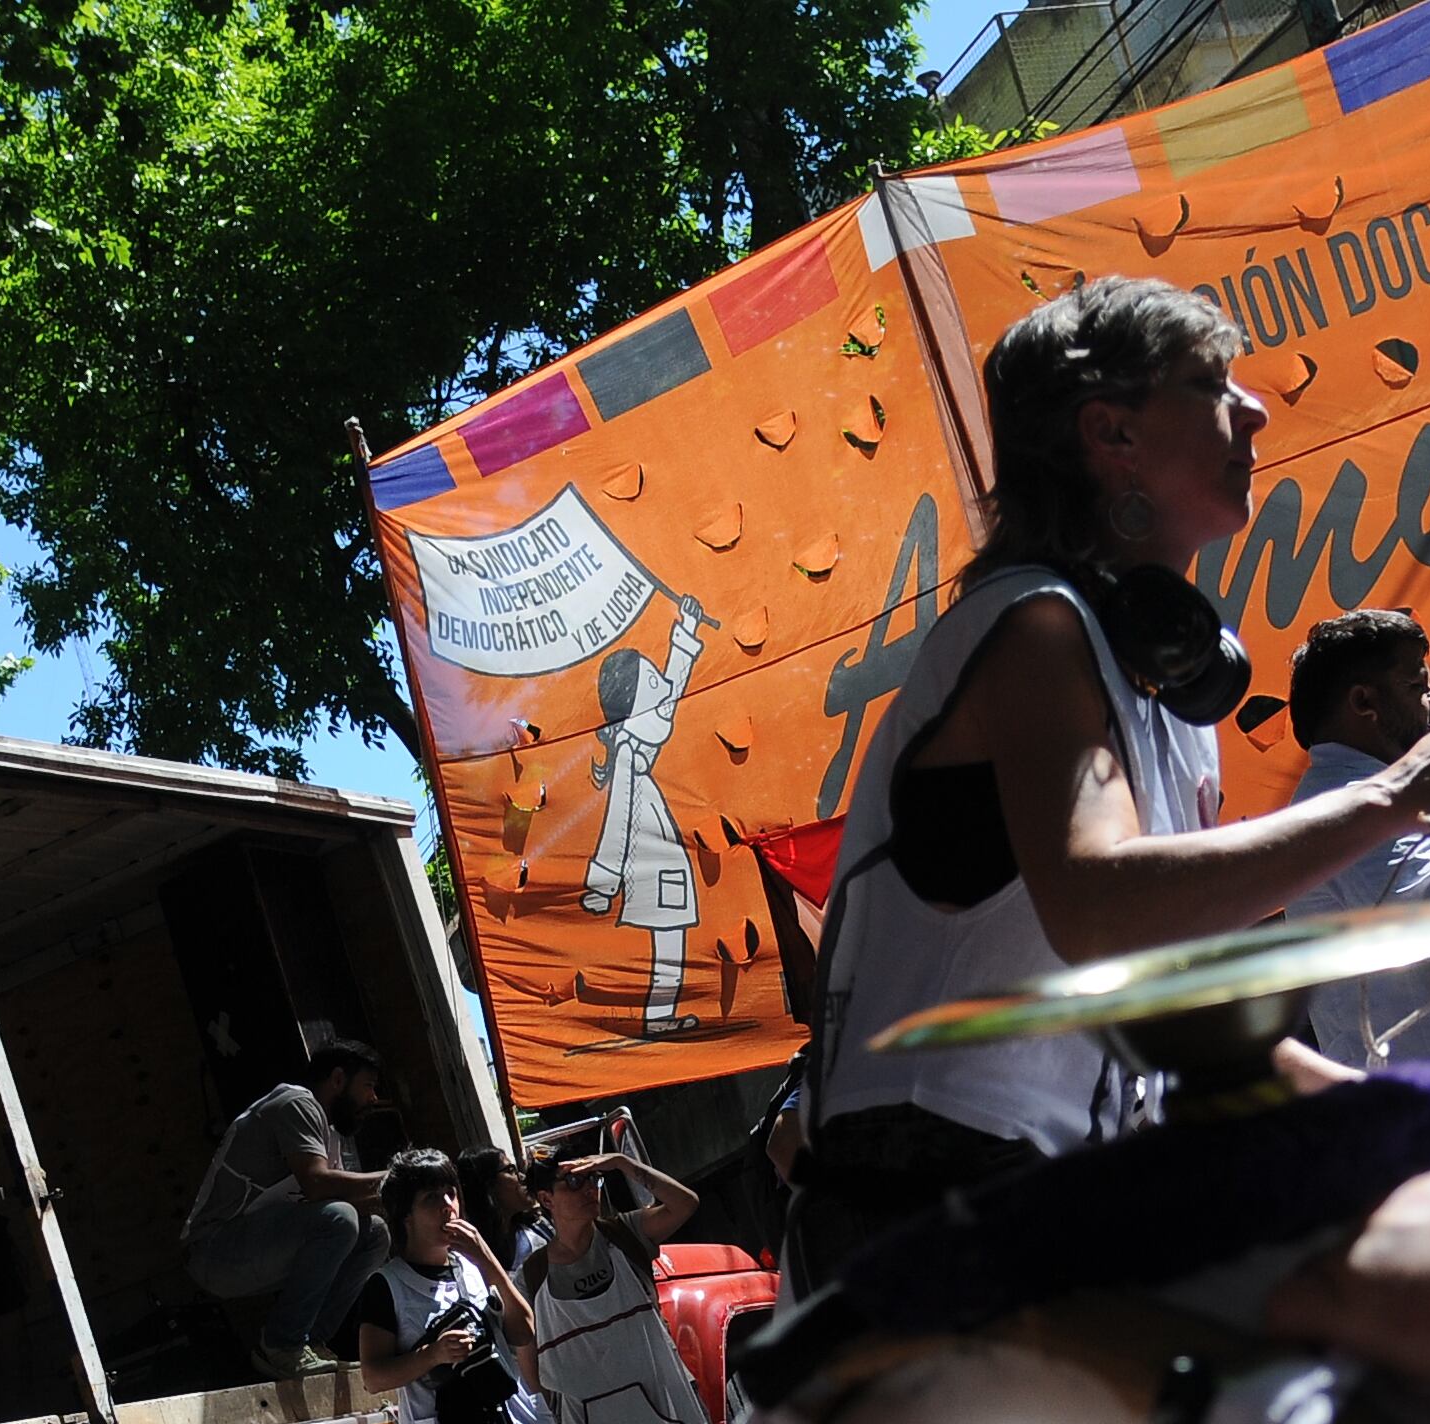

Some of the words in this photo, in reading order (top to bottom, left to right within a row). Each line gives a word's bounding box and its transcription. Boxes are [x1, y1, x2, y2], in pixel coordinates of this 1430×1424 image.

[467, 517, 571, 580] SINDICATO
[479, 543, 603, 616] INDEPENDIENTE
[438, 609, 568, 652] DEMOCRÁTICO
[571, 629, 587, 654] Y
[584, 617, 607, 647] DE
[601, 571, 647, 632] LUCHA
[574, 1269, 608, 1293] Que
